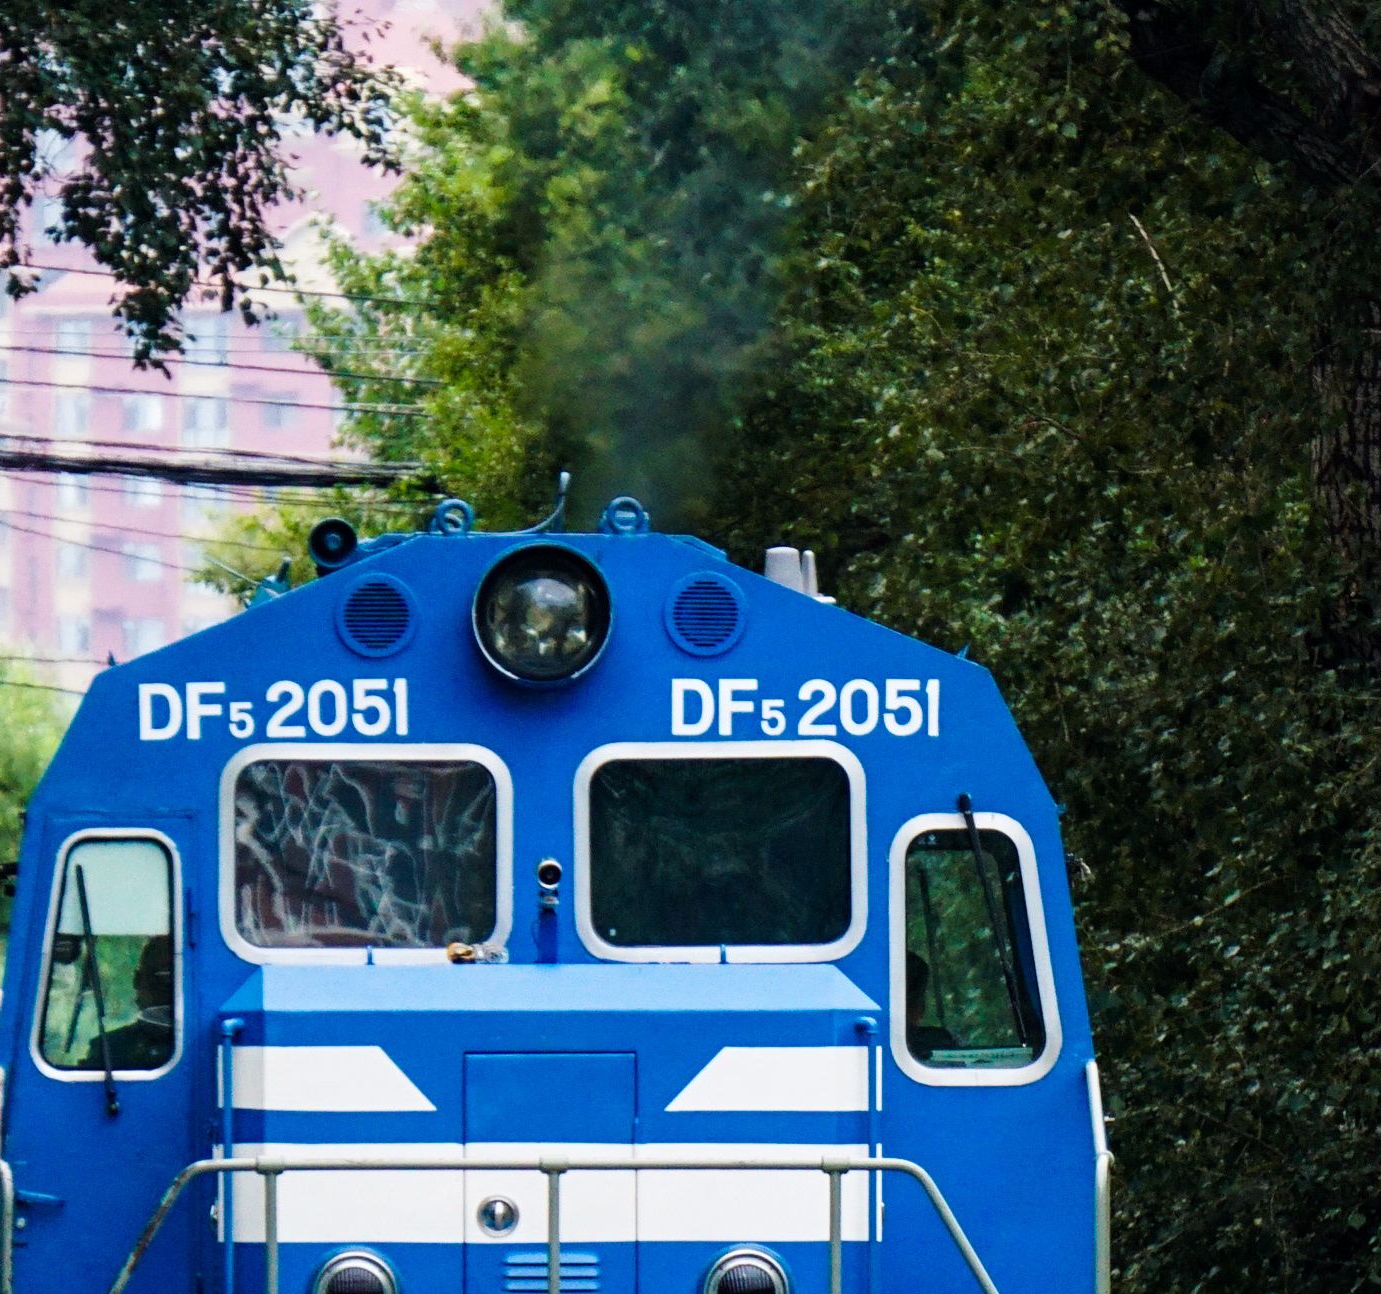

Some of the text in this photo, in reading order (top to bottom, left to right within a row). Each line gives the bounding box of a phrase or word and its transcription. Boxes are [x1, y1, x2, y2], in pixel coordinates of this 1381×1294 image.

[138, 677, 409, 740] DF5 2051
[671, 678, 941, 737] DF5 2051
